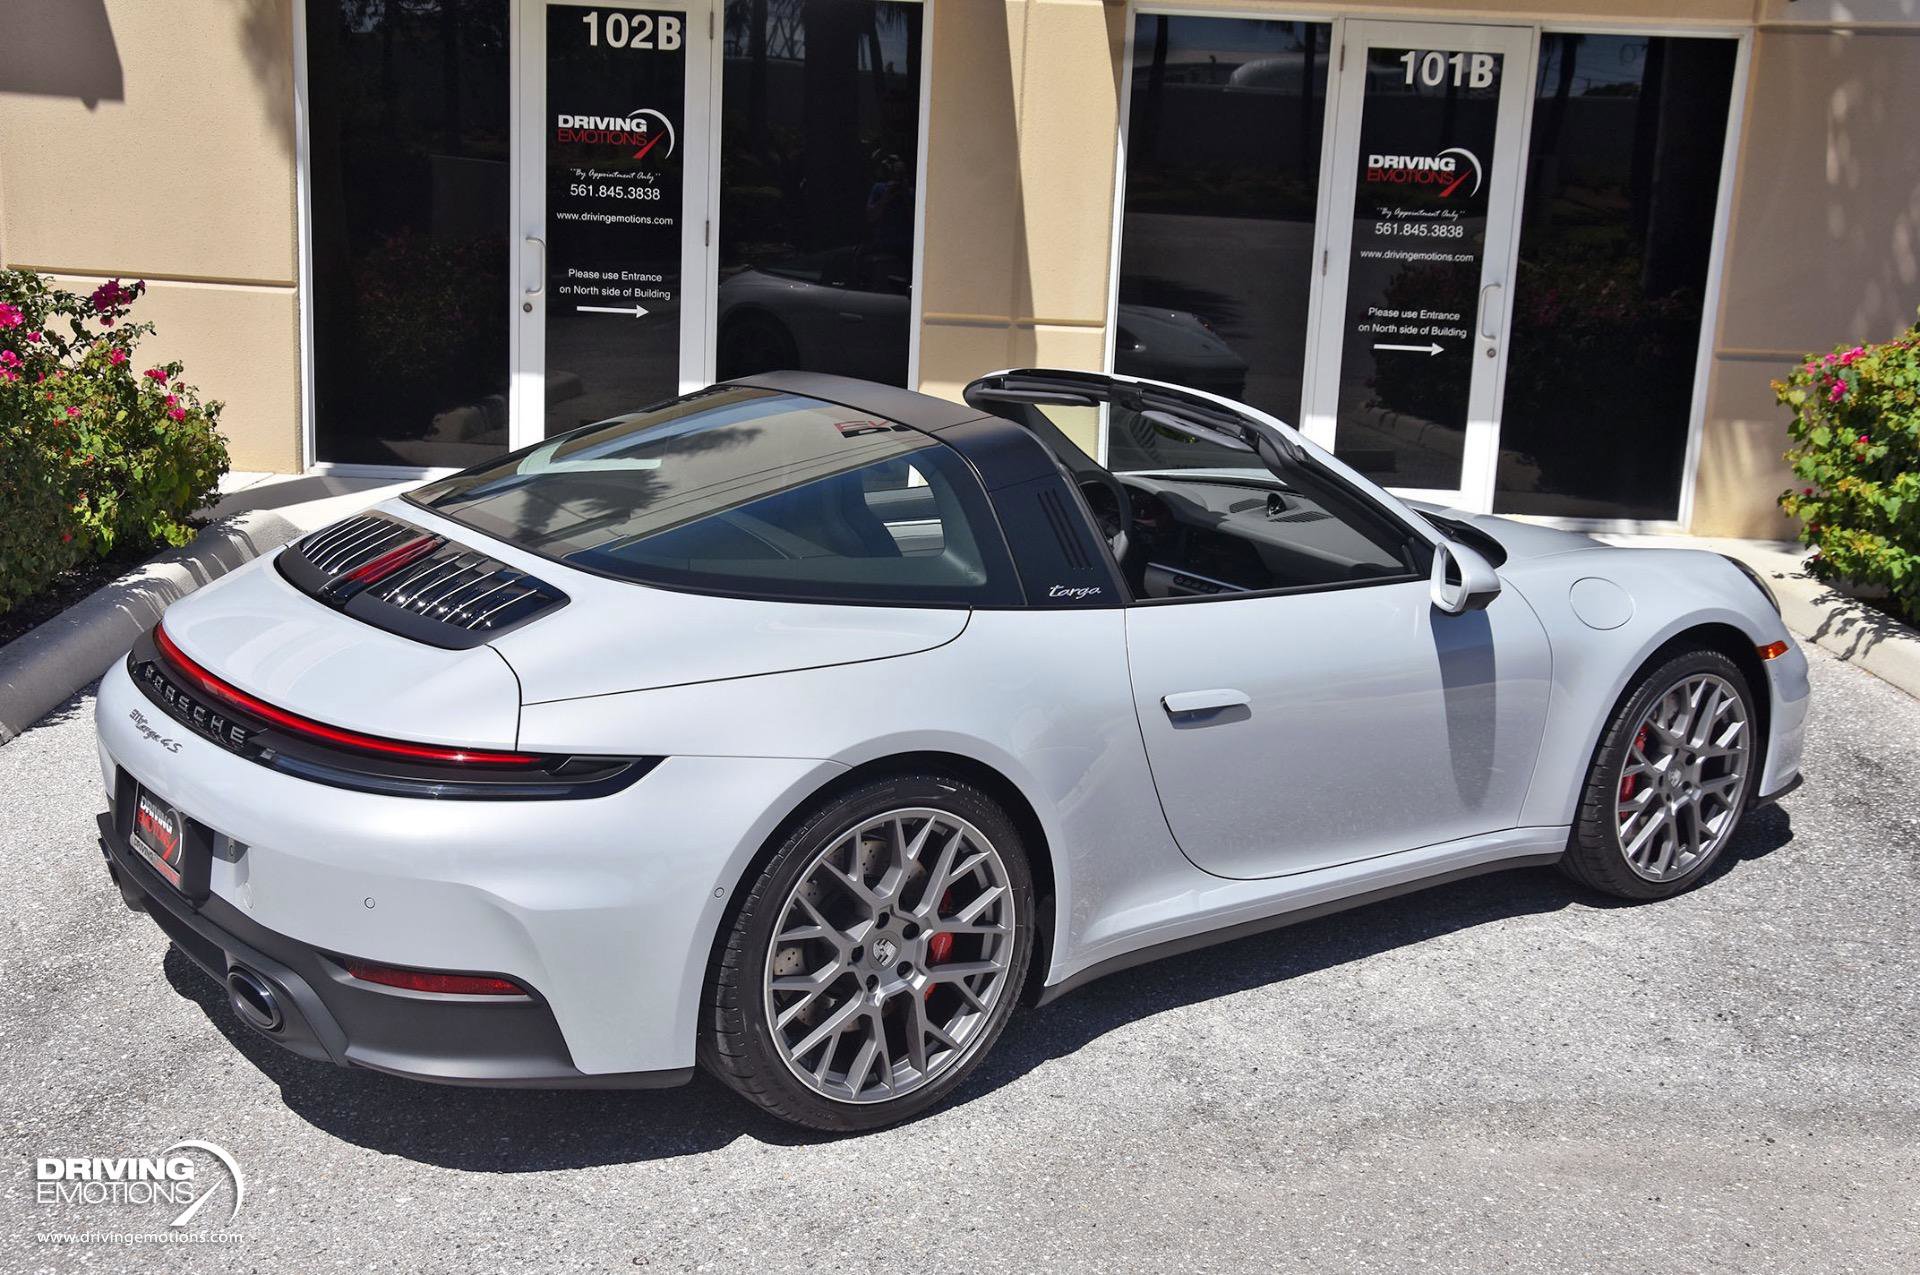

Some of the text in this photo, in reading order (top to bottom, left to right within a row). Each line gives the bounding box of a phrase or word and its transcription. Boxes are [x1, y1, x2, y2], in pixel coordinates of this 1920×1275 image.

[582, 11, 682, 51] 102B
[1400, 51, 1495, 88] 101B
[557, 114, 648, 133] DRIVING
[557, 128, 648, 147] EMOTIONS
[1368, 154, 1456, 172] DRIVING
[588, 168, 636, 180] Appointment
[1366, 168, 1456, 185] EMOTIONS
[570, 183, 661, 200] 561.845.3838
[556, 211, 674, 225] www.drivingemotions.com
[1393, 207, 1441, 219] Appointment
[1375, 222, 1464, 238] 561.845.3838
[1360, 250, 1474, 262] www.drivingemotions.com
[568, 268, 663, 282] Please use Entrance
[559, 285, 671, 300] on North side of Building
[1368, 307, 1460, 321] Please use Entrance
[1358, 323, 1467, 339] on North side of Building
[1048, 584, 1102, 600] targa
[144, 665, 246, 744] PORSCHE
